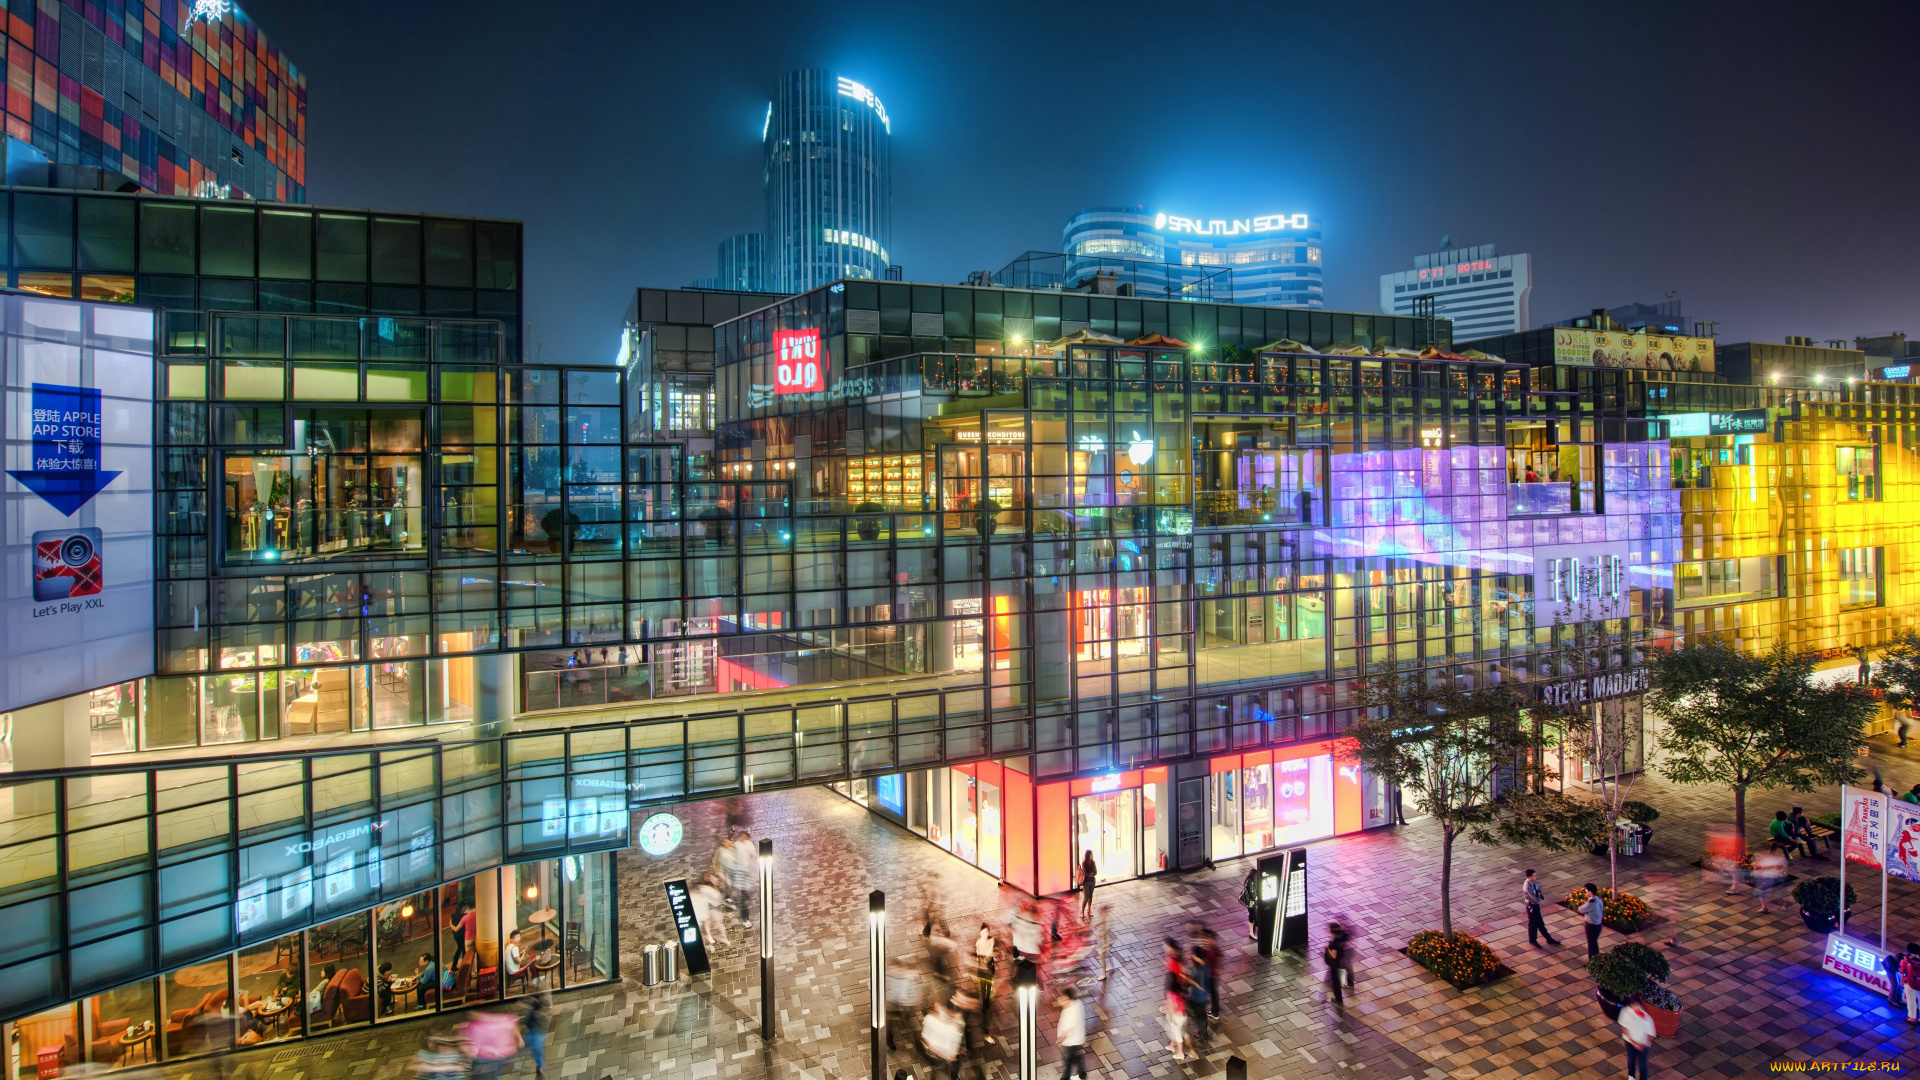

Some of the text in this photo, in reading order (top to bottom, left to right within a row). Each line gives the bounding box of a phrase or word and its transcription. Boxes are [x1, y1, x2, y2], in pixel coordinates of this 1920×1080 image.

[1169, 214, 1308, 235] SANLITUN SOHO
[1457, 260, 1492, 273] HOTEL
[33, 409, 100, 424] 登陆 APPLE
[33, 424, 100, 438] APP STORE
[52, 439, 84, 454] 下载
[36, 458, 97, 470] 体验大惊喜!
[33, 598, 105, 618] Let's Play XXL
[1544, 668, 1649, 705] STEVE MADDEN
[1824, 955, 1890, 991] FESTIVAL
